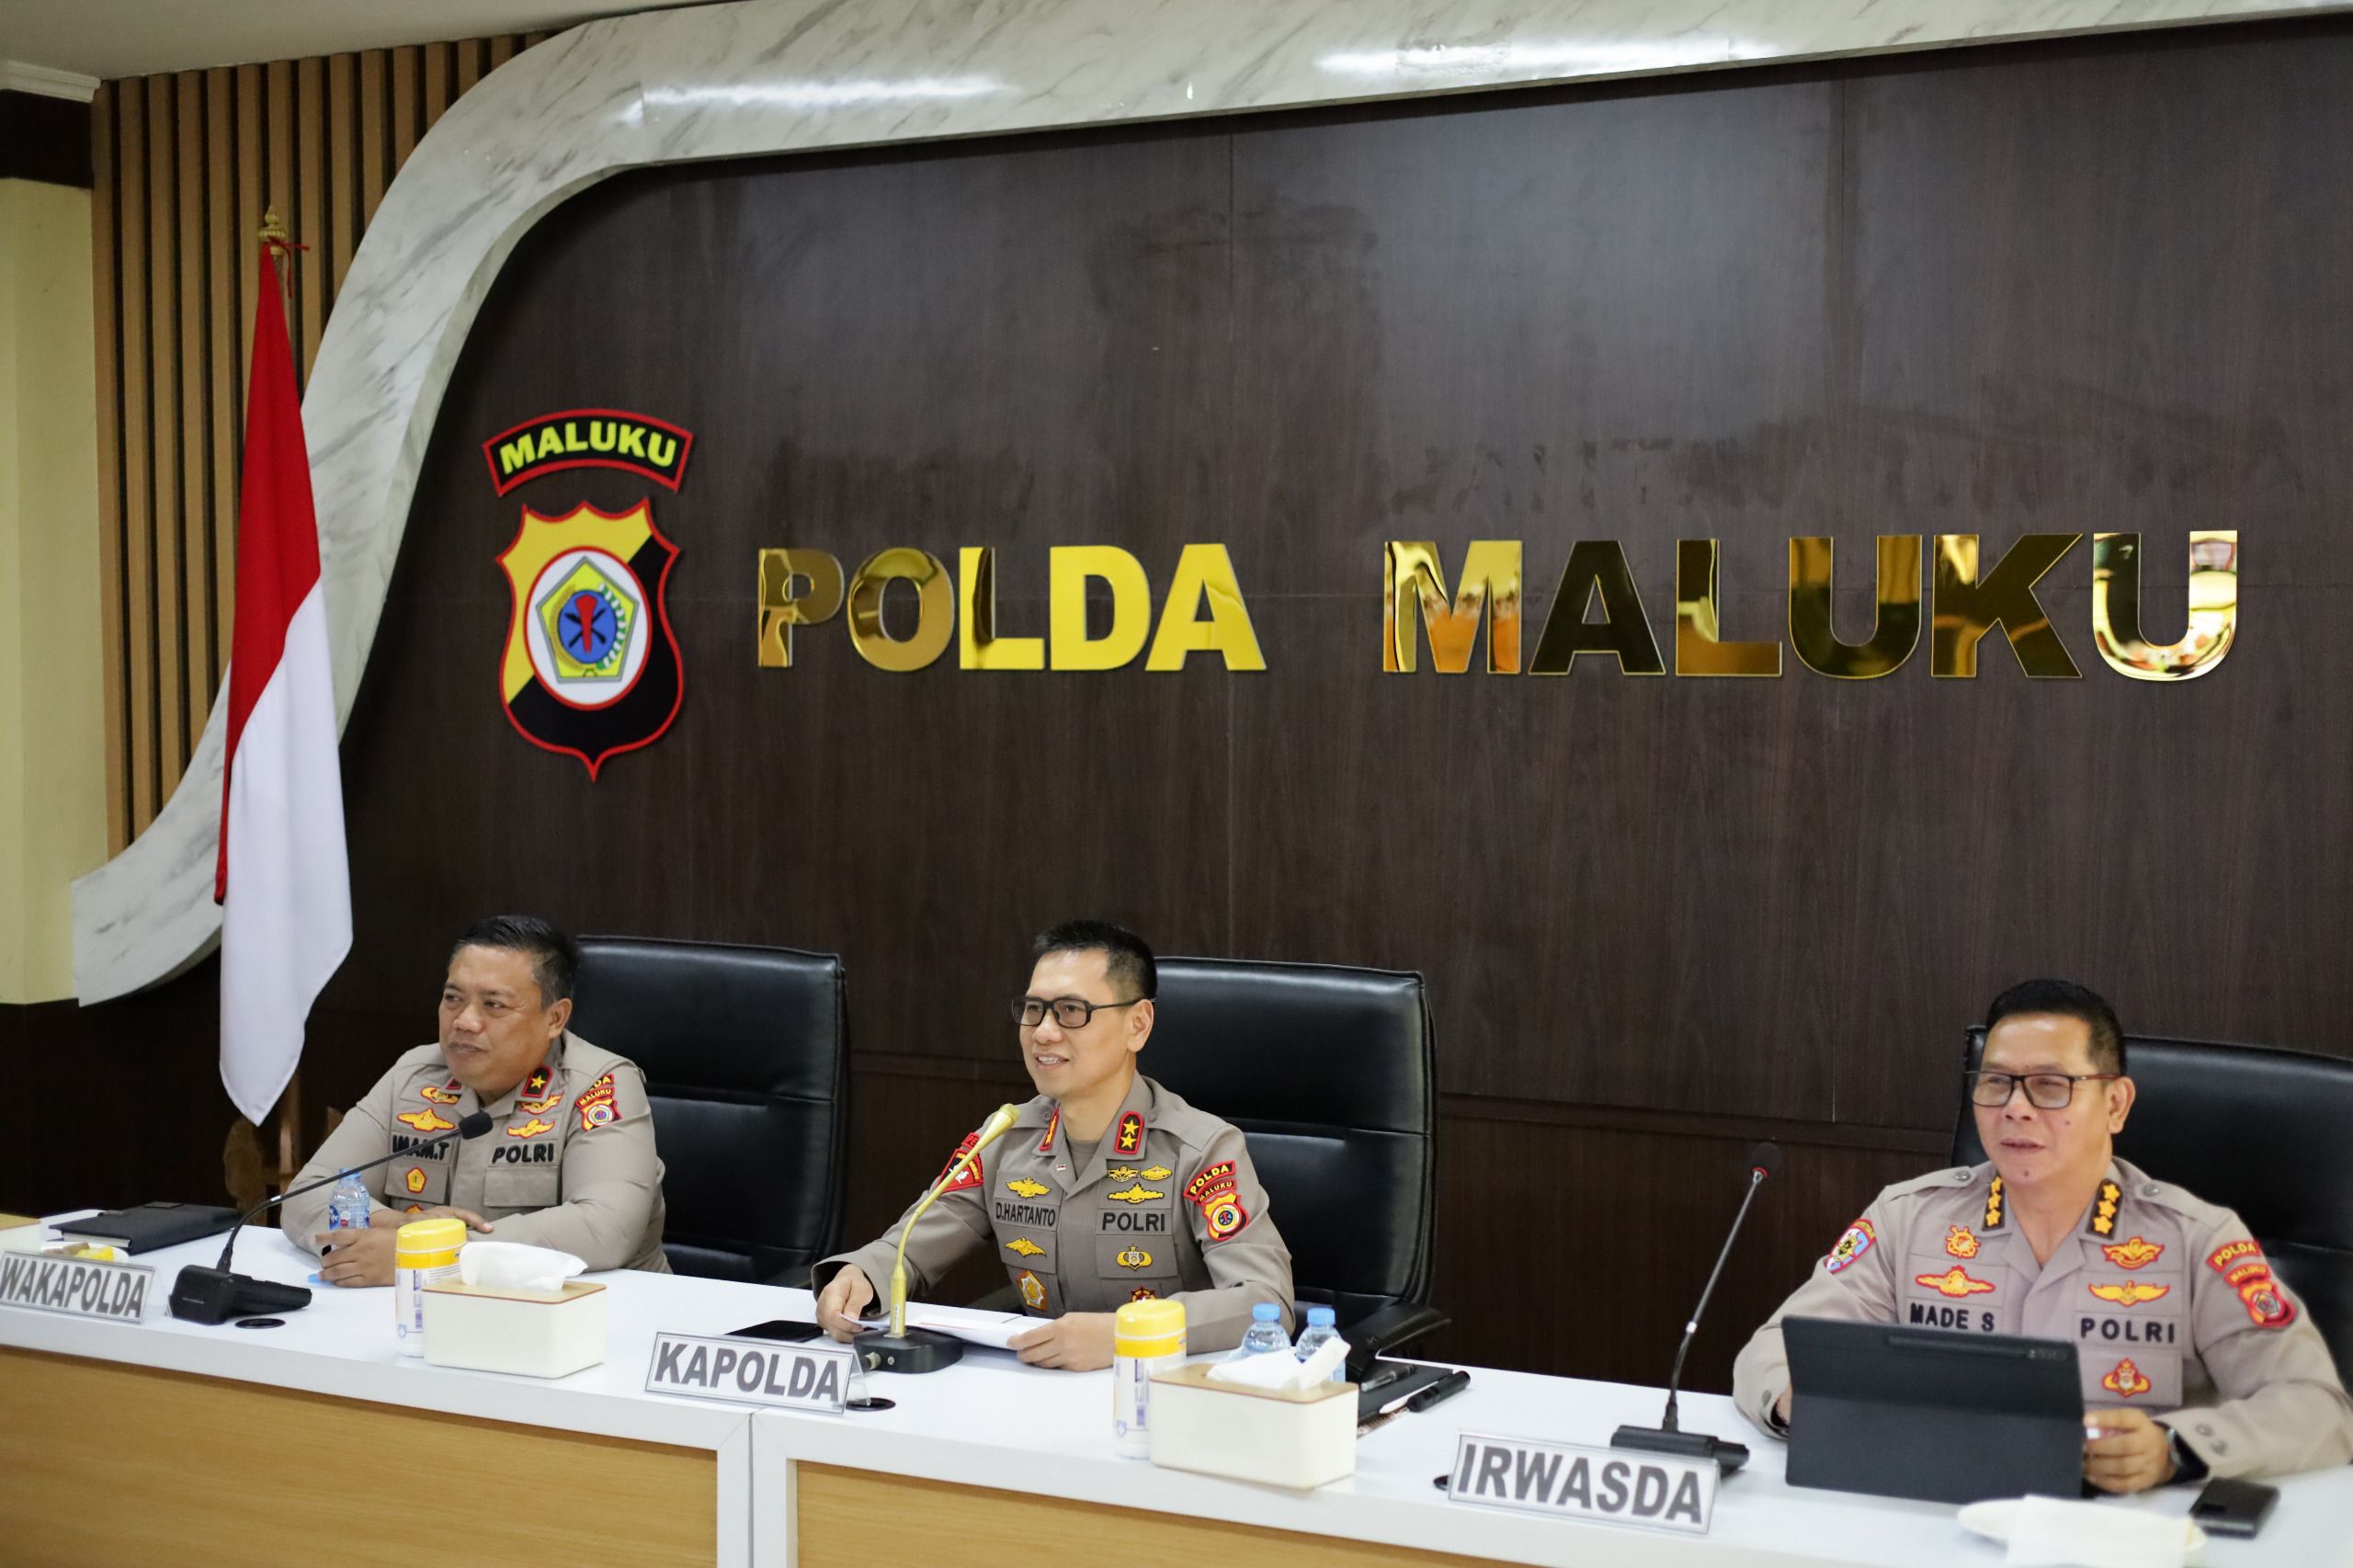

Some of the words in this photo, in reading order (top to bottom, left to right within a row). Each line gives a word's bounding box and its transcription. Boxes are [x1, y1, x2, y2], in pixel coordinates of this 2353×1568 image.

[499, 421, 676, 474] MALUKU
[757, 543, 1267, 672] POLDA
[1382, 530, 2238, 680] MALUKU
[579, 1088, 612, 1106] MALUKU
[492, 1143, 554, 1164] POLRI
[1189, 1165, 1229, 1194] POLDA
[1199, 1181, 1233, 1202] MALUKU
[995, 1202, 1056, 1227] D.HARTANTO
[1102, 1211, 1165, 1232] POLRI
[2214, 1243, 2256, 1267] POLDA
[0, 1256, 146, 1318] WAKAPOLDA
[1910, 1302, 1969, 1329] MADE
[1982, 1312, 1995, 1332] S
[2081, 1317, 2175, 1344] POLRI
[654, 1341, 839, 1403] KAPOLDA
[1458, 1443, 1703, 1525] IRWASDA
